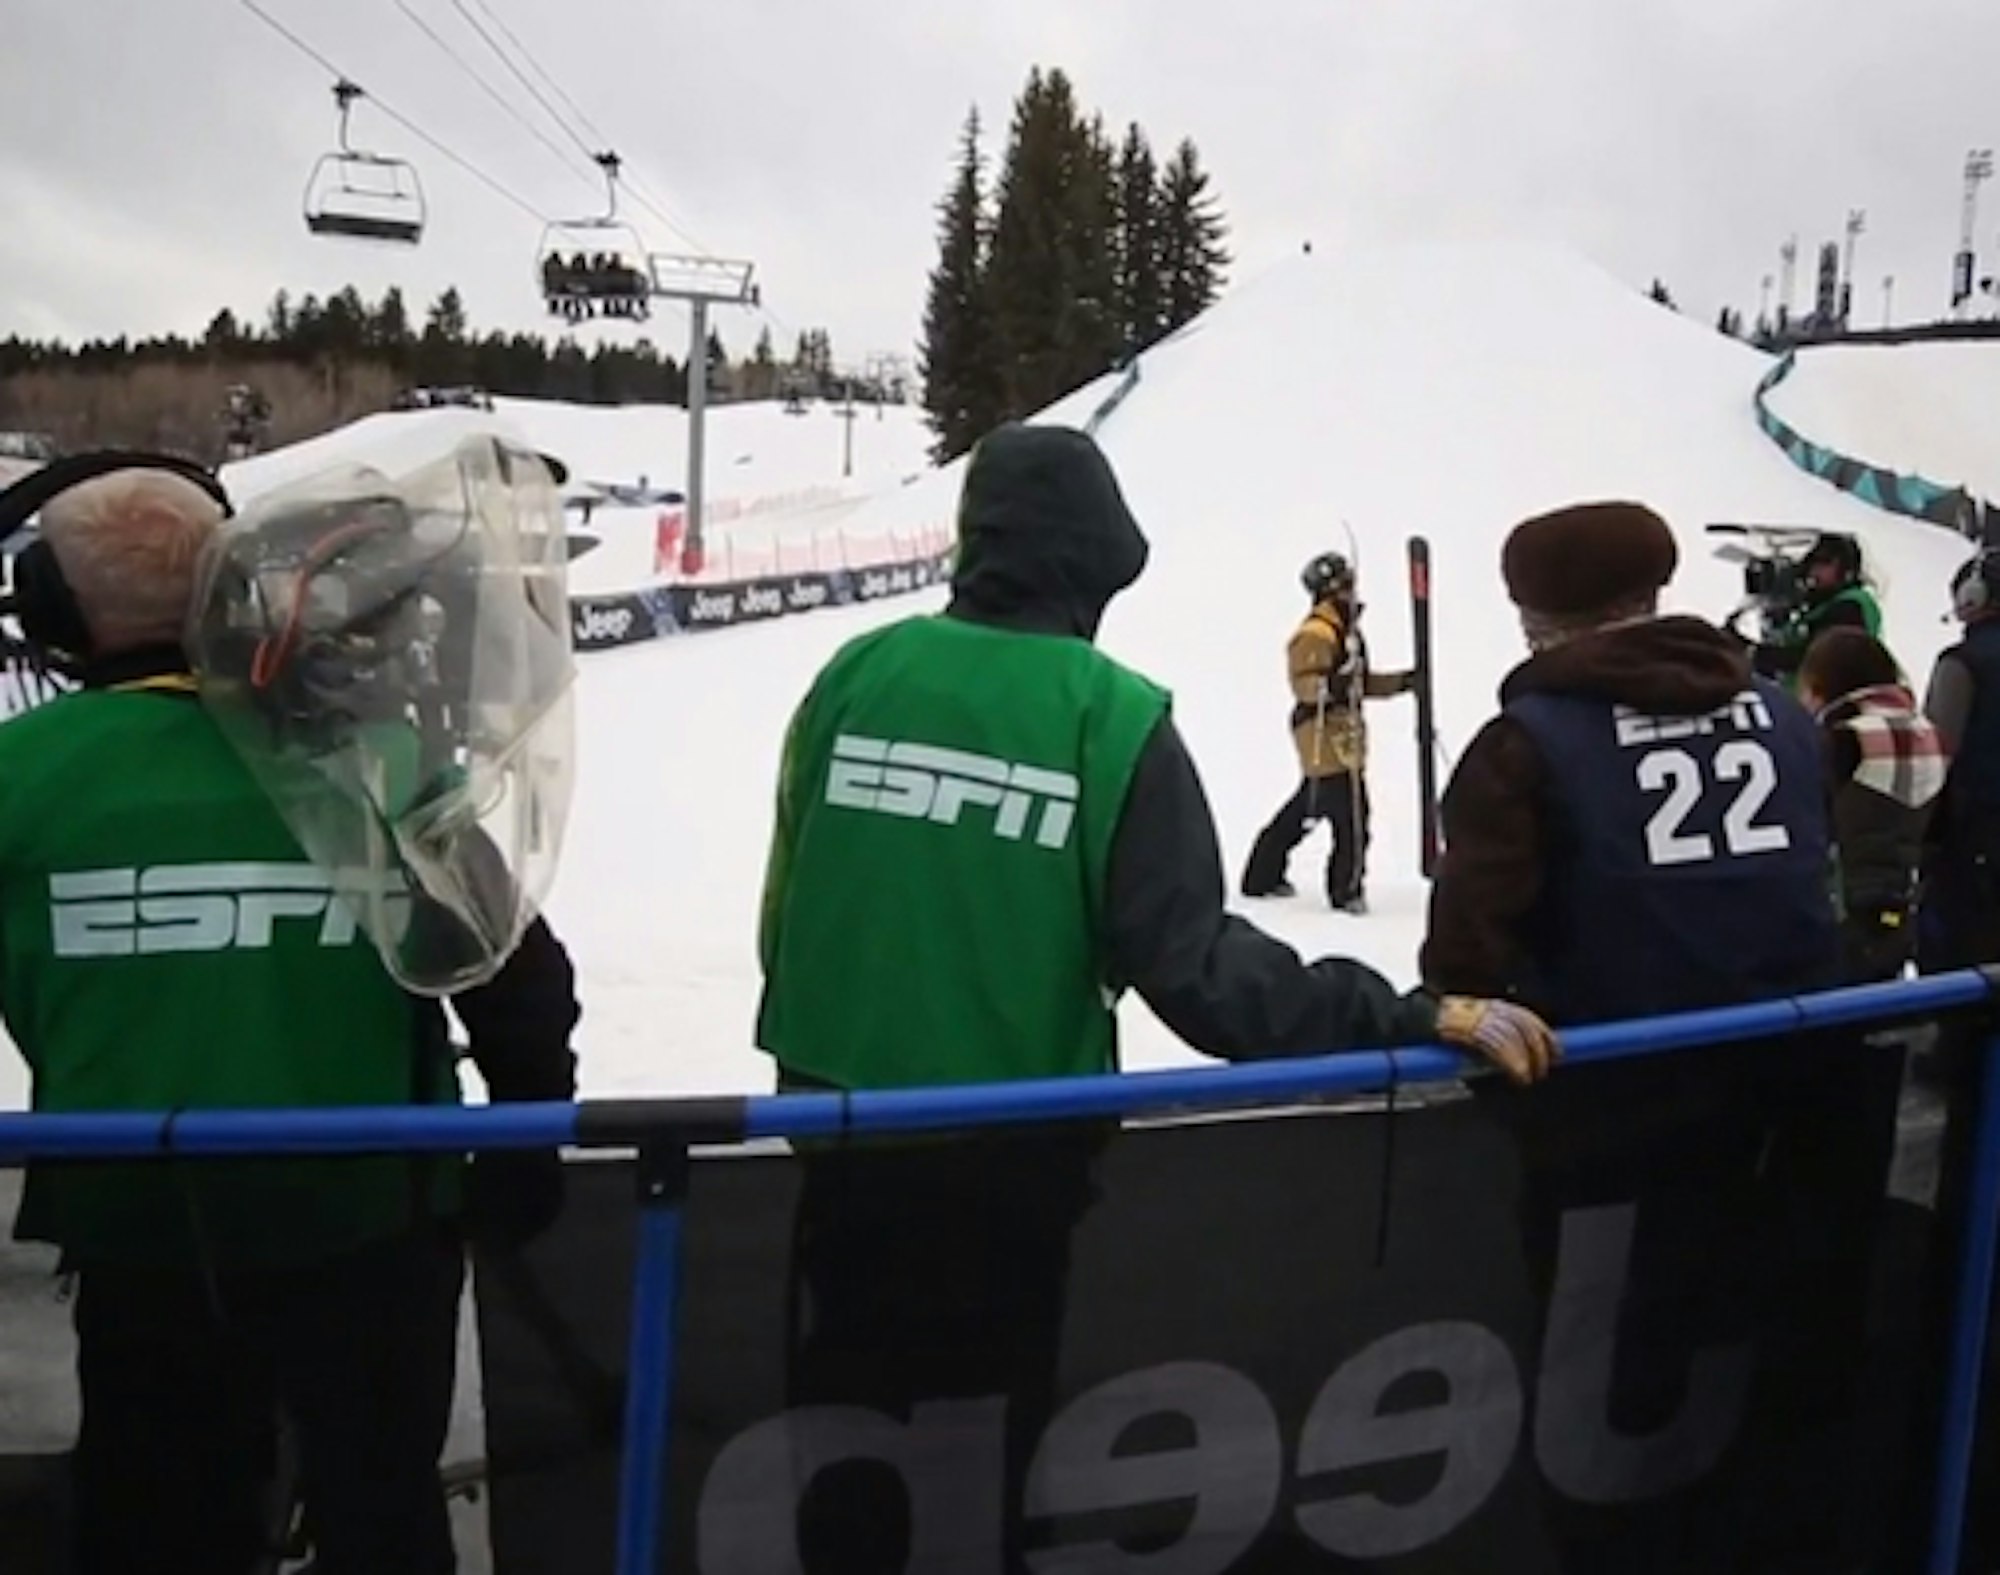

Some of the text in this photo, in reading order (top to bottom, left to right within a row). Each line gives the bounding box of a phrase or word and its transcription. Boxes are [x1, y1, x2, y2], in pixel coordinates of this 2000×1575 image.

[576, 604, 632, 640] Jeep
[690, 578, 827, 620] Jeep Jeep Jeep
[824, 733, 1081, 849] ESPN
[1635, 739, 1791, 865] 22
